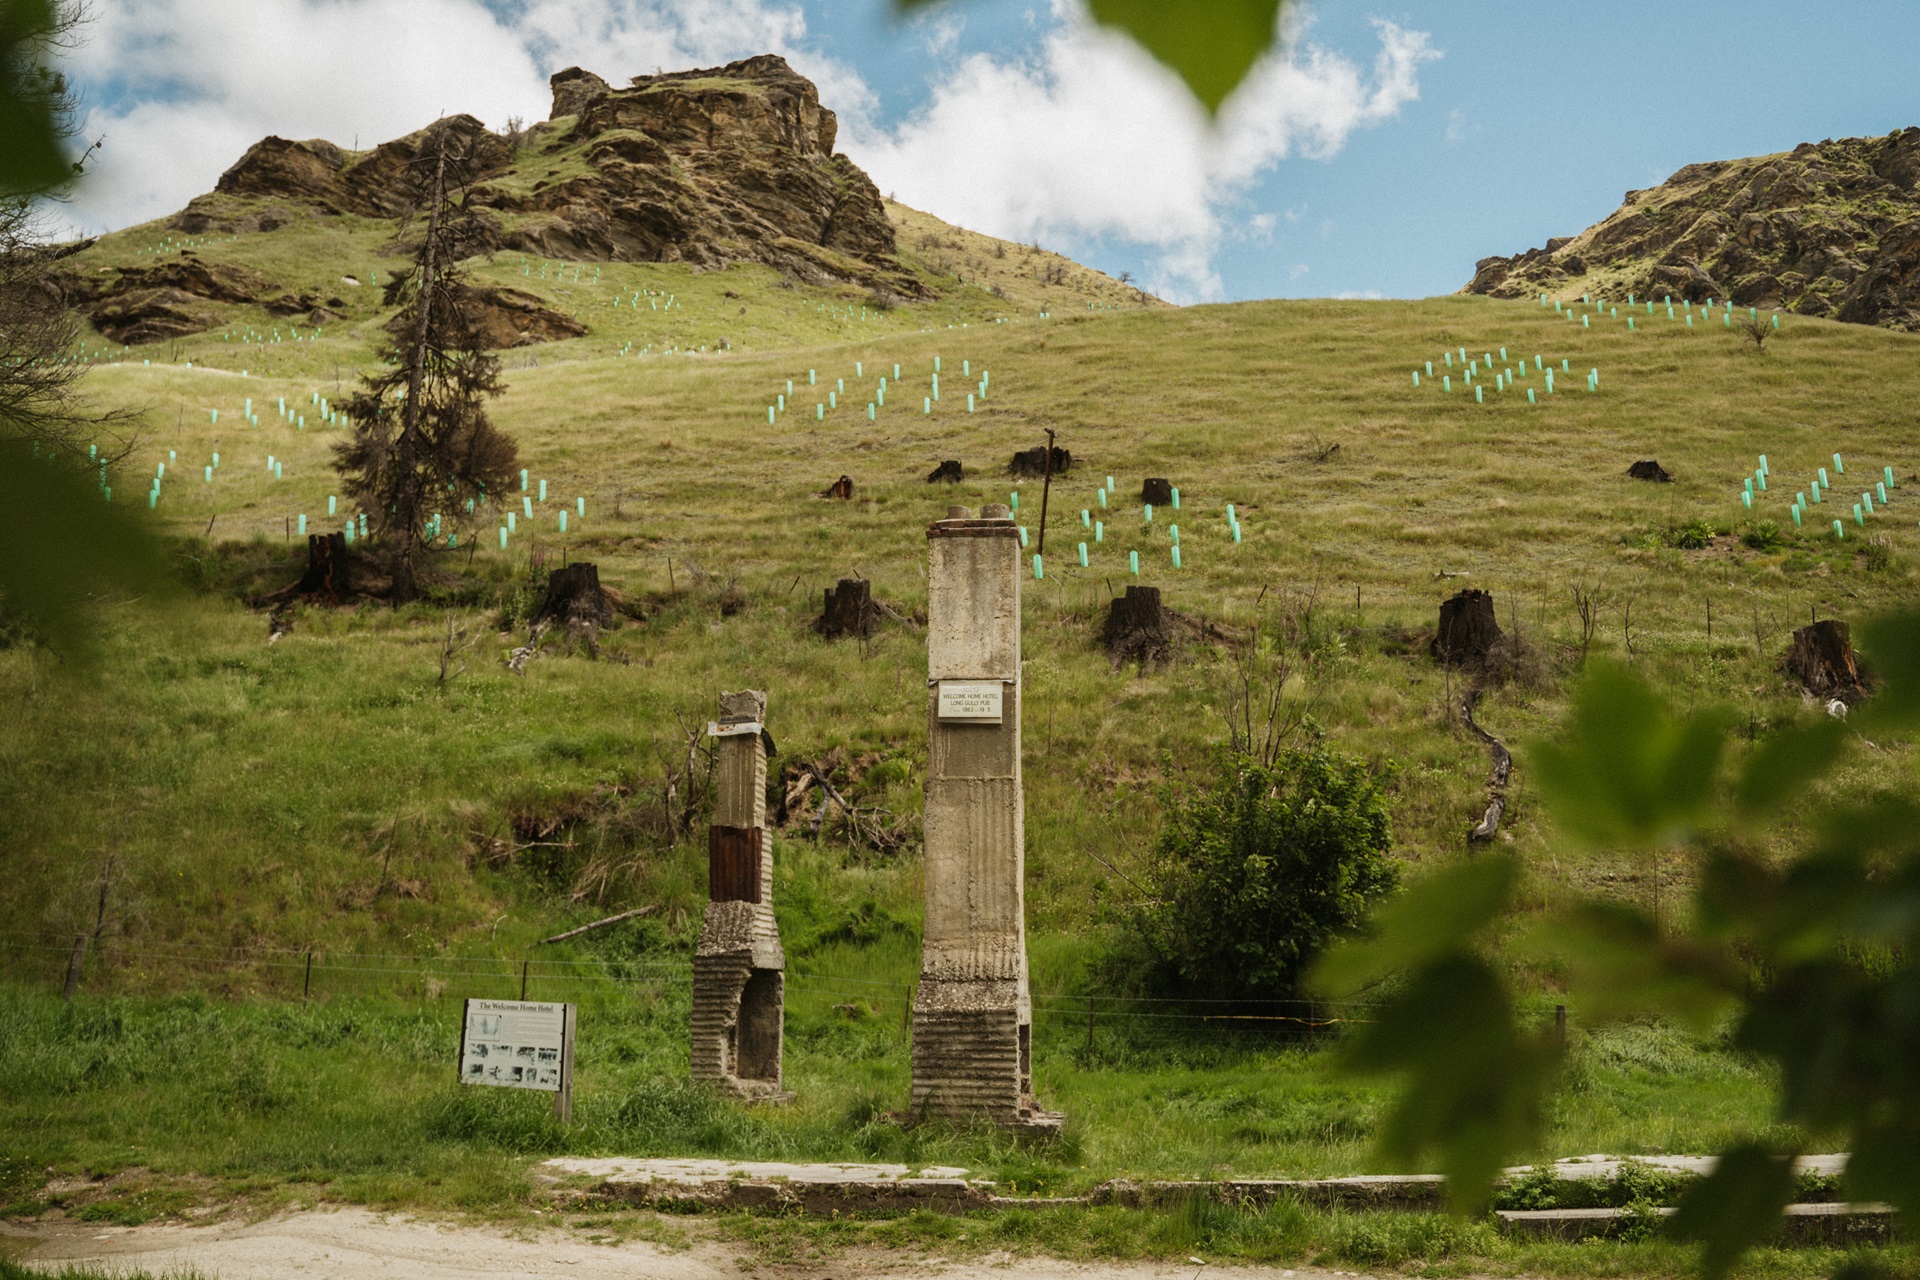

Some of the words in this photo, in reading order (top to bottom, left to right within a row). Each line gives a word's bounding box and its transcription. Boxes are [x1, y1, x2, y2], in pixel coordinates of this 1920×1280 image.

[480, 1001, 491, 1009] The
[492, 1002, 518, 1010] Welcome
[520, 1004, 537, 1012] Home
[538, 1004, 554, 1012] Hotel
